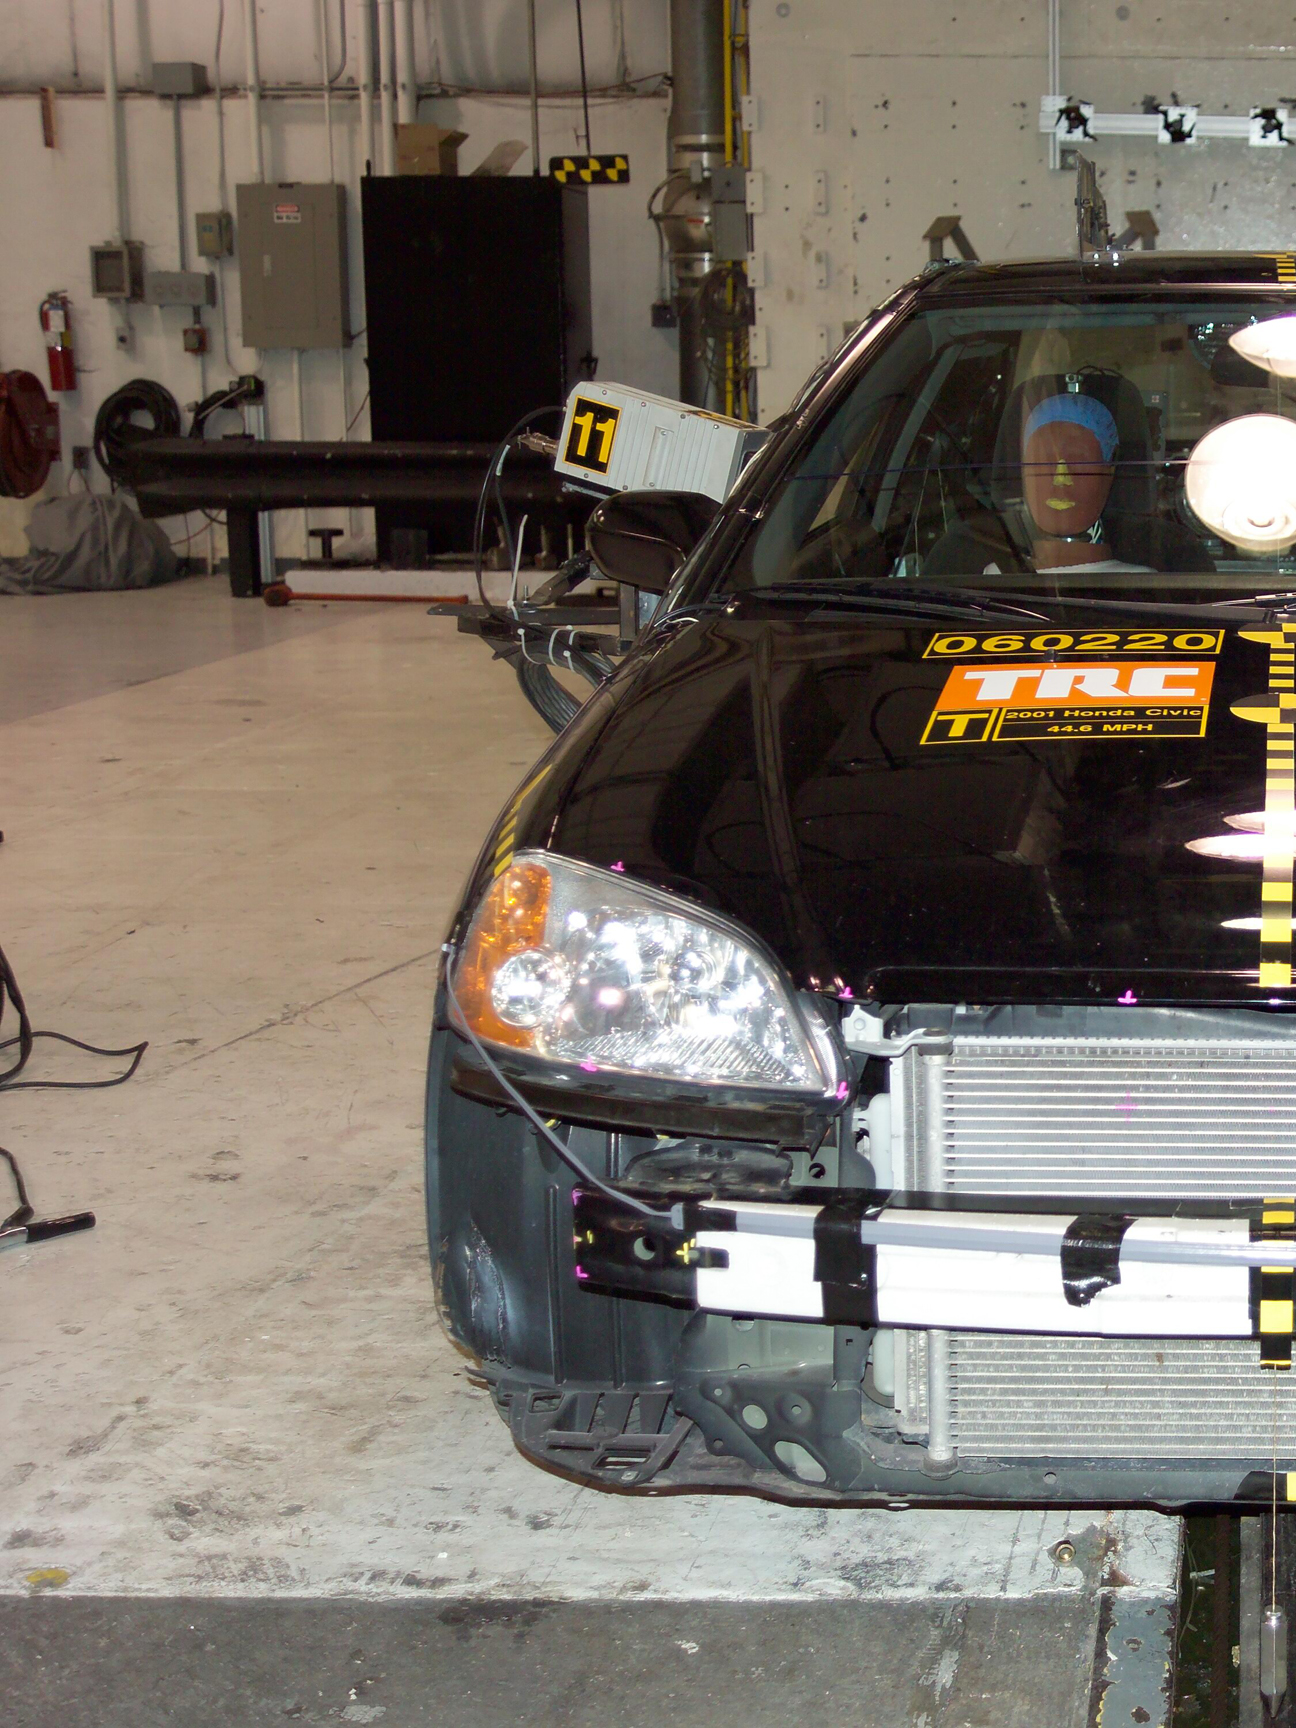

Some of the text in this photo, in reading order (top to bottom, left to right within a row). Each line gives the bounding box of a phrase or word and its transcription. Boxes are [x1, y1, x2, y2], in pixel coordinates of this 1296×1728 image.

[574, 411, 616, 464] 11
[933, 633, 1216, 654] 060220
[963, 667, 1199, 700] TRC
[1005, 708, 1202, 719] 2001 Honda Civic
[937, 713, 989, 737] T
[1047, 724, 1153, 733] 44.6 MPH
